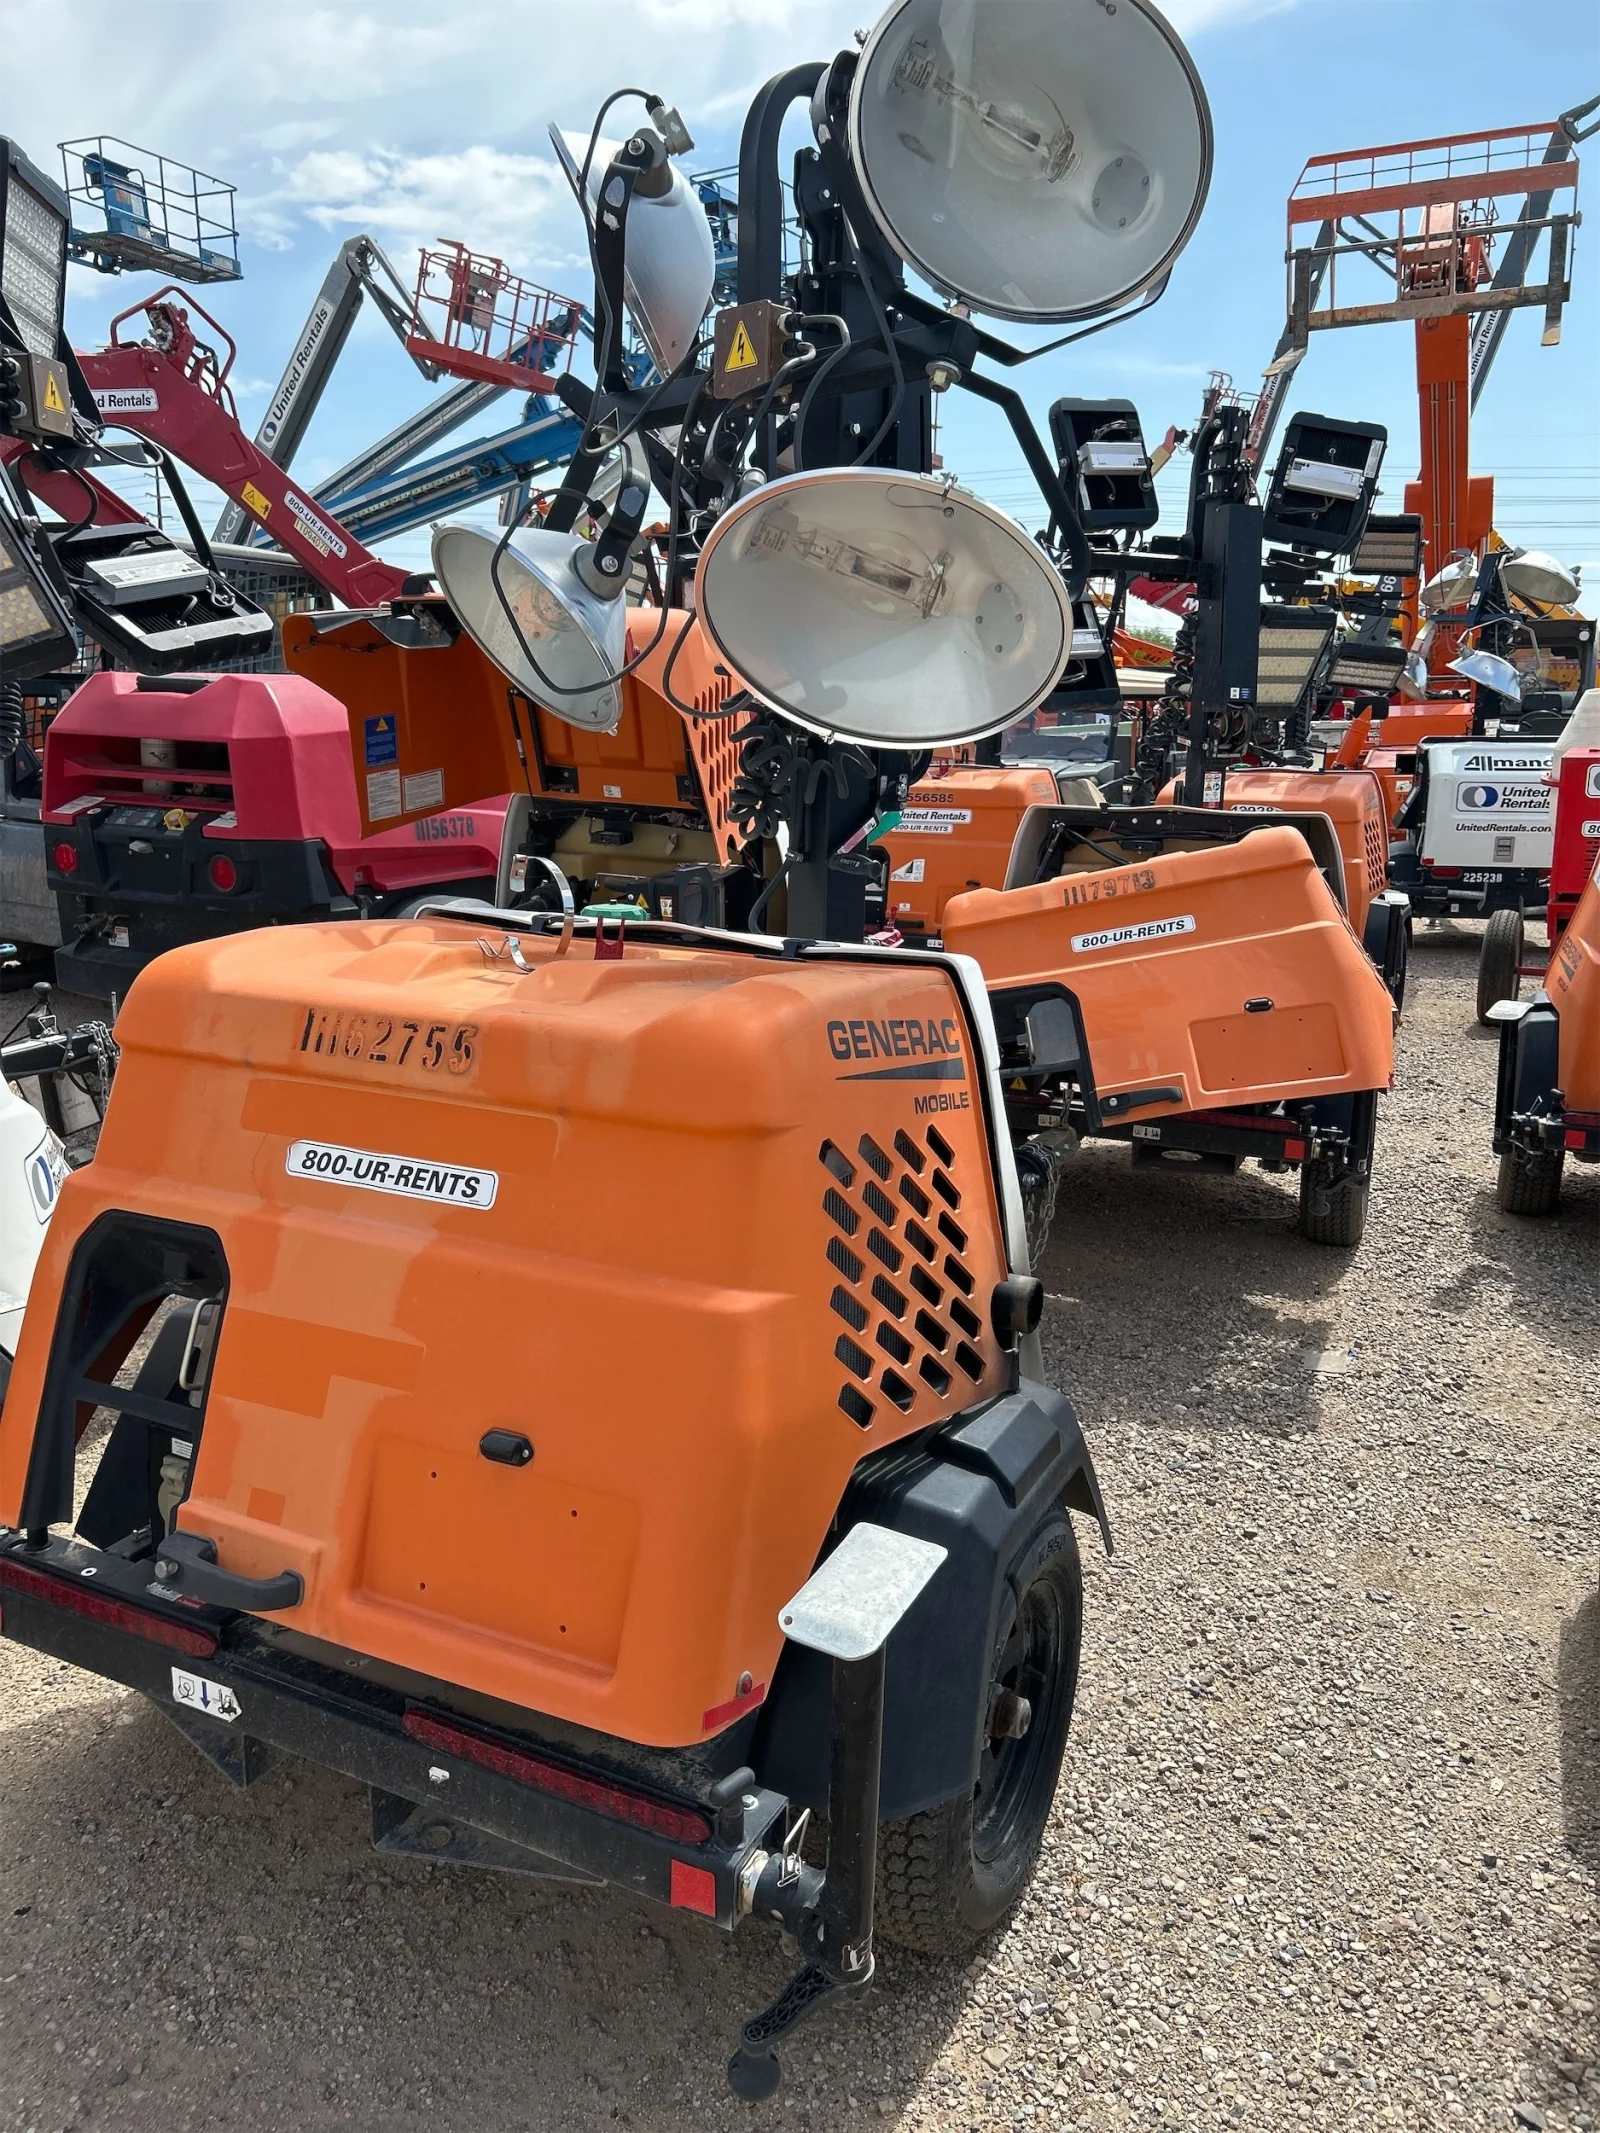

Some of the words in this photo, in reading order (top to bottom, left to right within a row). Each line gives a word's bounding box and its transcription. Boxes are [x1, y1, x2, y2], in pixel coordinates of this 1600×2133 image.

[273, 366, 301, 422] United
[297, 308, 328, 369] Rentals
[108, 394, 152, 407] Rentals
[288, 497, 344, 553] 800-UR-RENTS
[1502, 787, 1551, 797] United
[930, 811, 967, 820] Rentals
[1463, 873, 1503, 883] 225238
[1081, 919, 1185, 948] 800-UR-RENTS
[827, 1019, 960, 1060] GENERAC
[914, 1092, 969, 1114] MOBILE
[301, 1149, 481, 1199] 800-UR-RENTS
